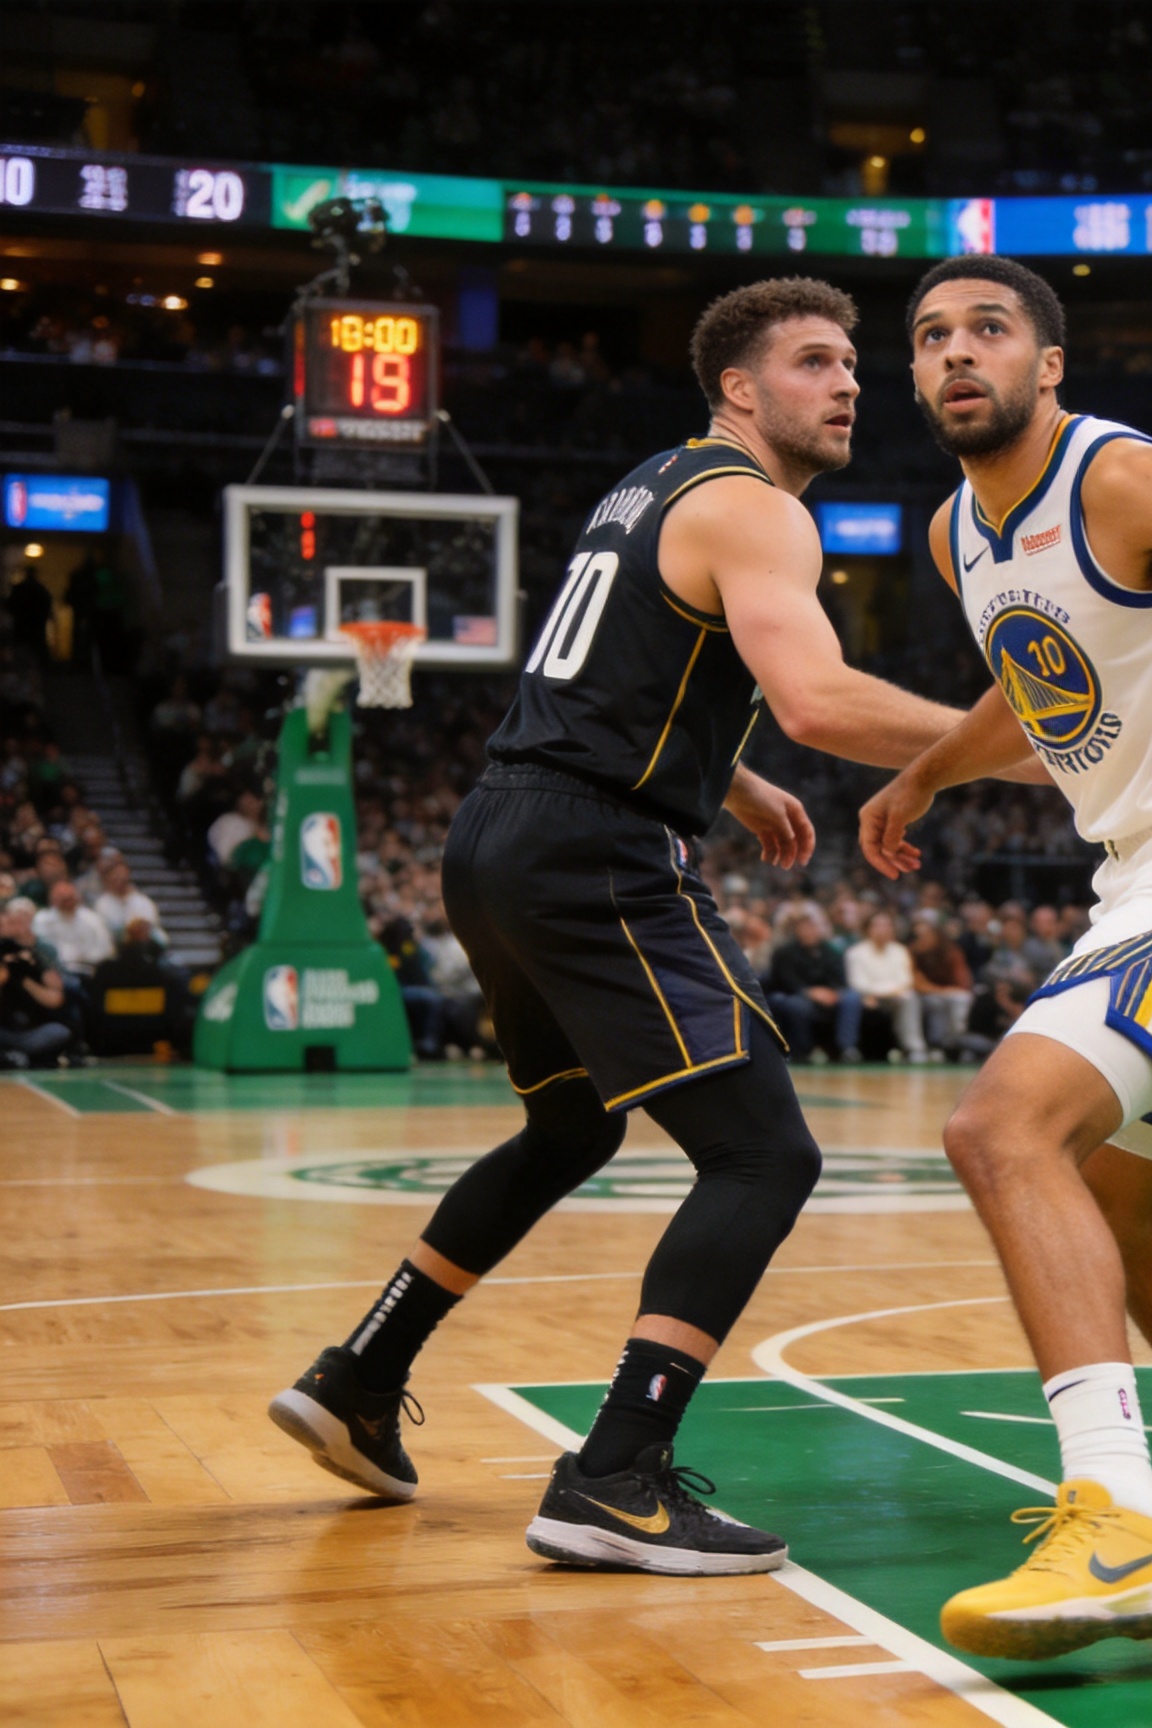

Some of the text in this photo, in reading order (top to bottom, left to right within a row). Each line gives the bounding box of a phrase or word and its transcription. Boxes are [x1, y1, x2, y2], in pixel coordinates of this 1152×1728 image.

[186, 169, 244, 221] 20
[525, 551, 619, 680] 10
[1027, 635, 1067, 677] 10
